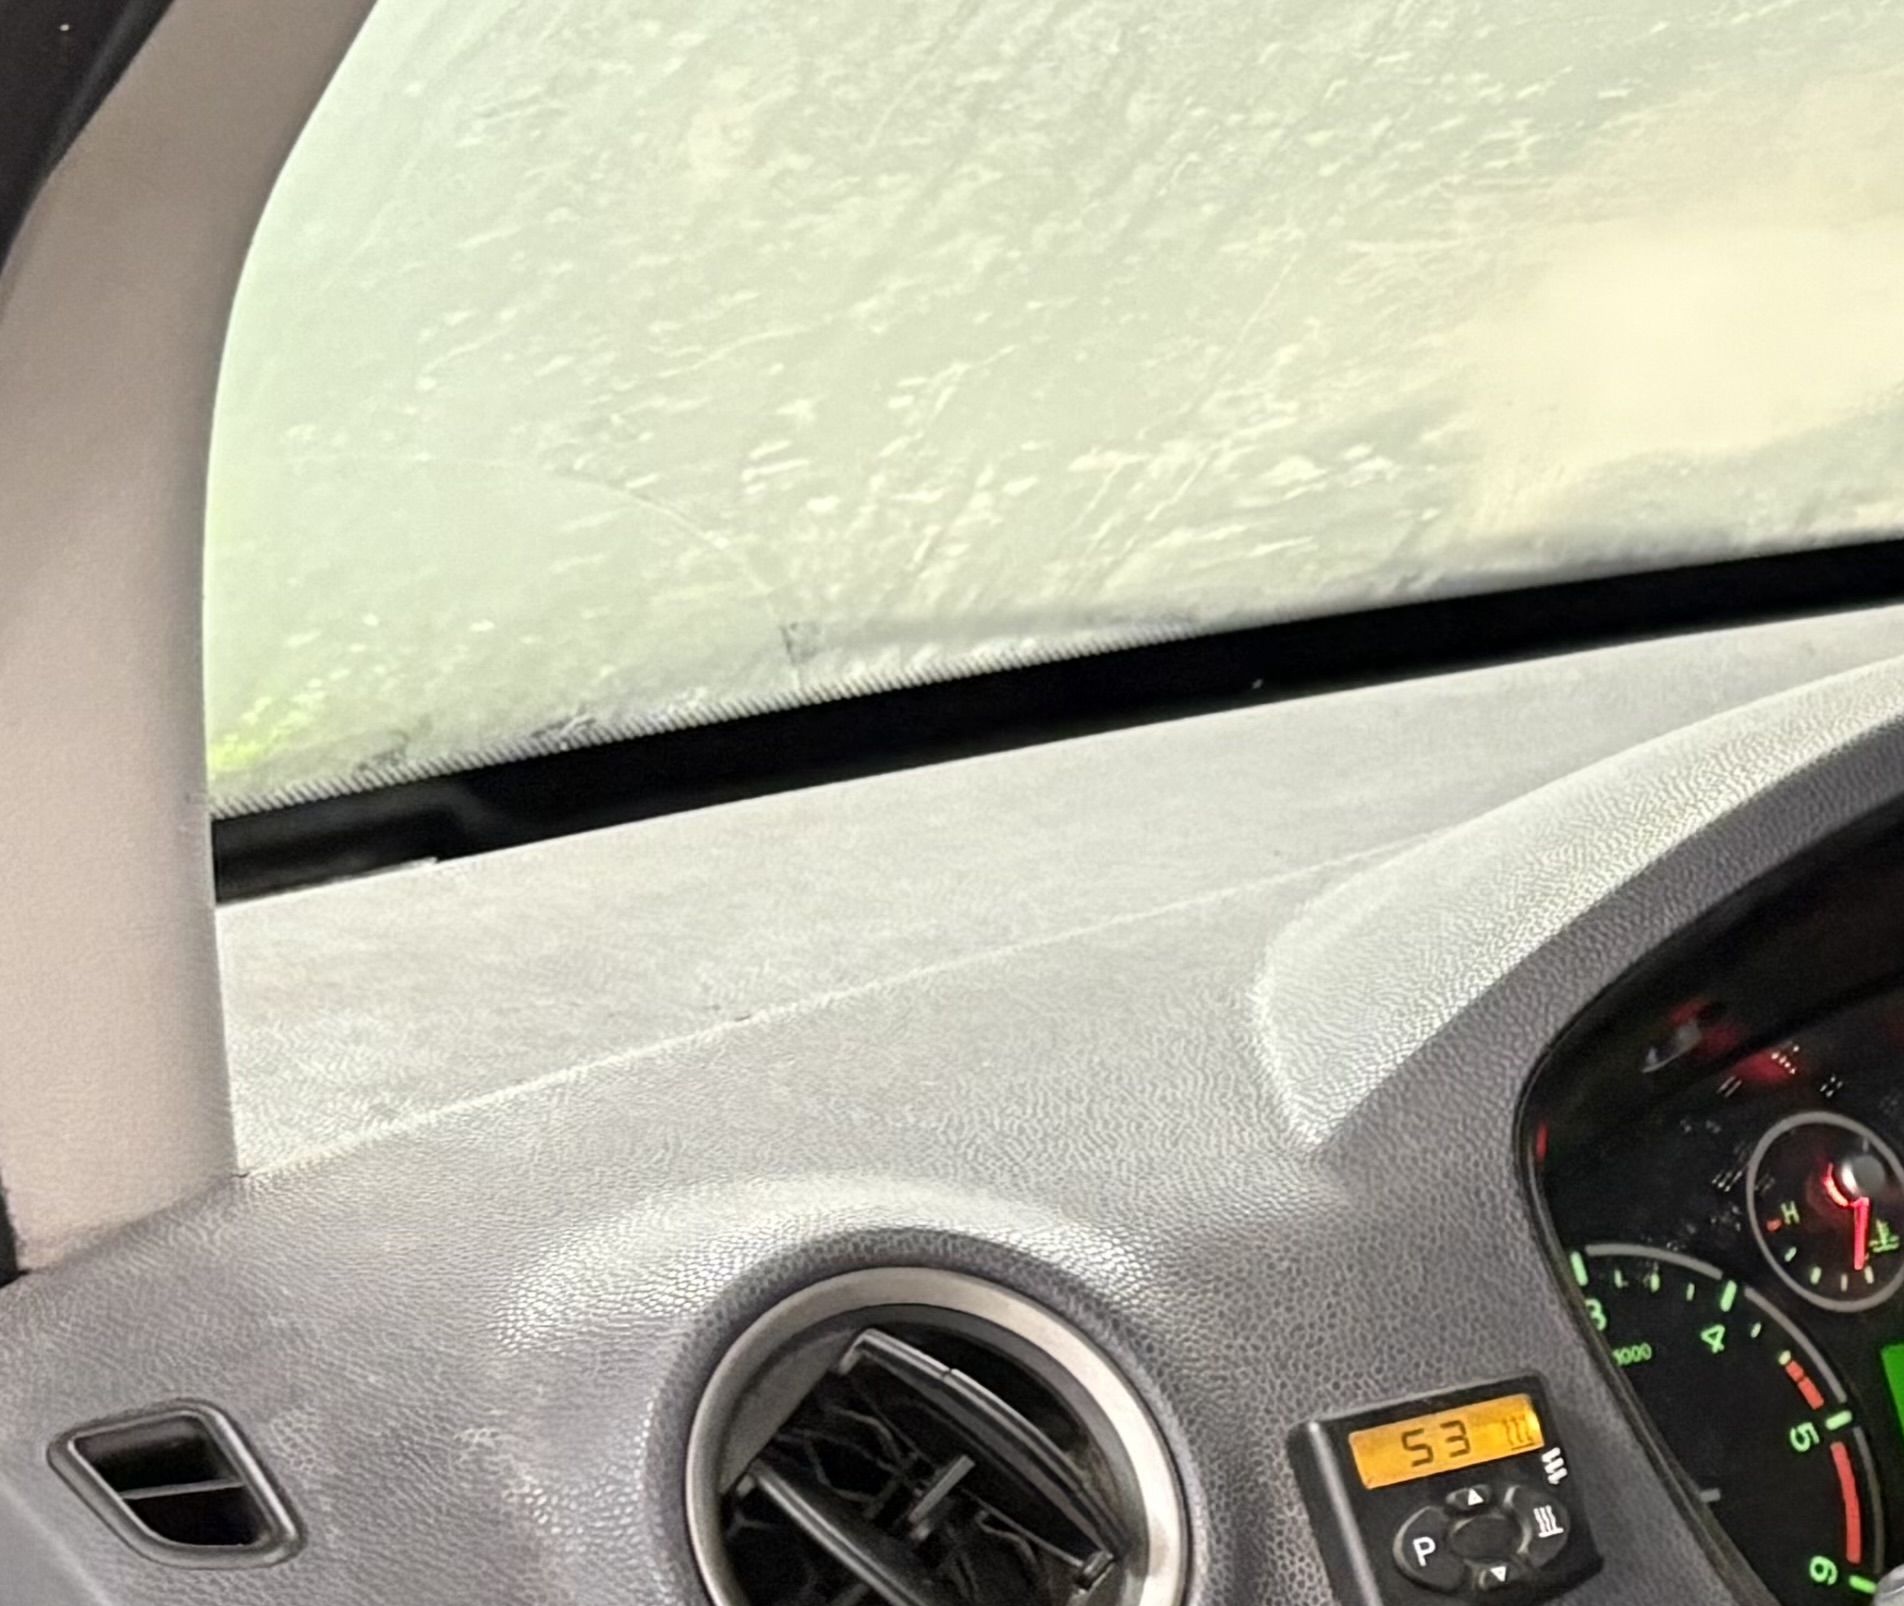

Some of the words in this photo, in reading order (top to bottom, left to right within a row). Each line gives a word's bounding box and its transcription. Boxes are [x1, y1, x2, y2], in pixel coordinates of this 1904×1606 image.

[1780, 1200, 1800, 1226] H
[1584, 1298, 1607, 1331] 3
[1701, 1323, 1726, 1354] 4
[1788, 1421, 1821, 1453] 5
[1413, 1536, 1437, 1567] P
[1808, 1555, 1839, 1587] 6
